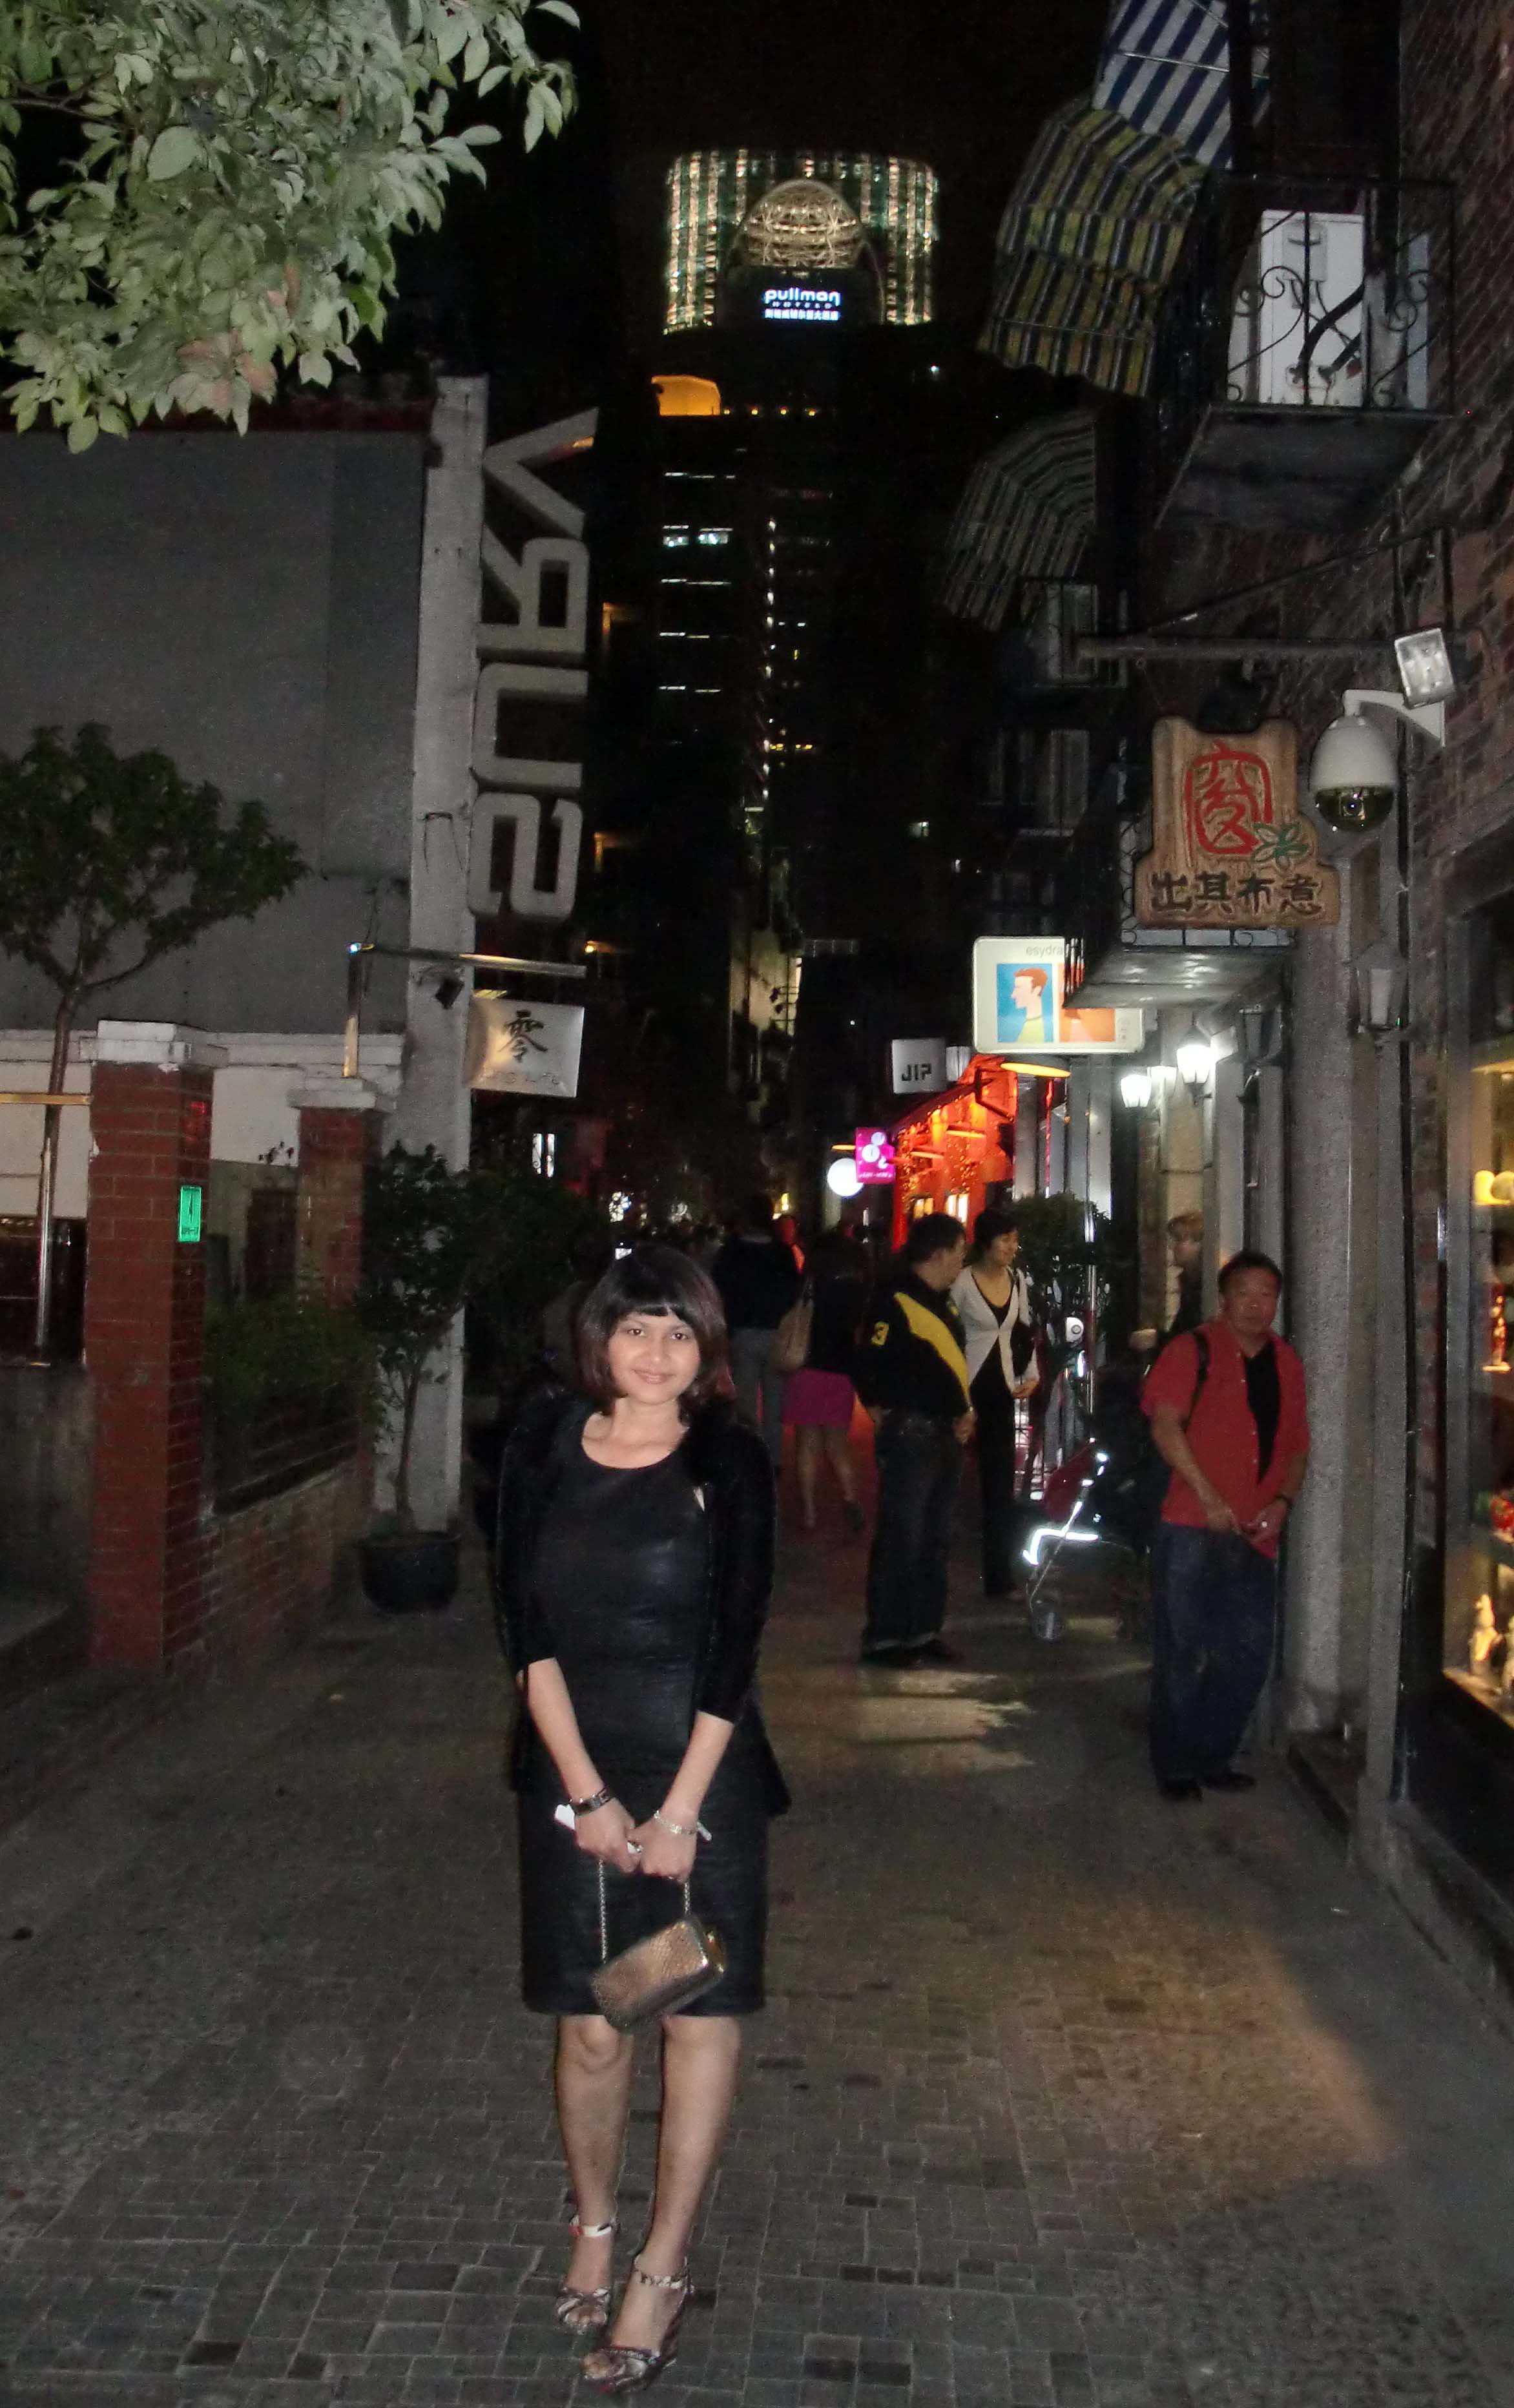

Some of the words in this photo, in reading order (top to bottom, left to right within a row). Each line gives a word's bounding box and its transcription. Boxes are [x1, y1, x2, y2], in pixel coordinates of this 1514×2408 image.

[765, 287, 840, 306] pullman
[1151, 869, 1323, 918] 出其布意
[901, 1063, 932, 1081] JIP
